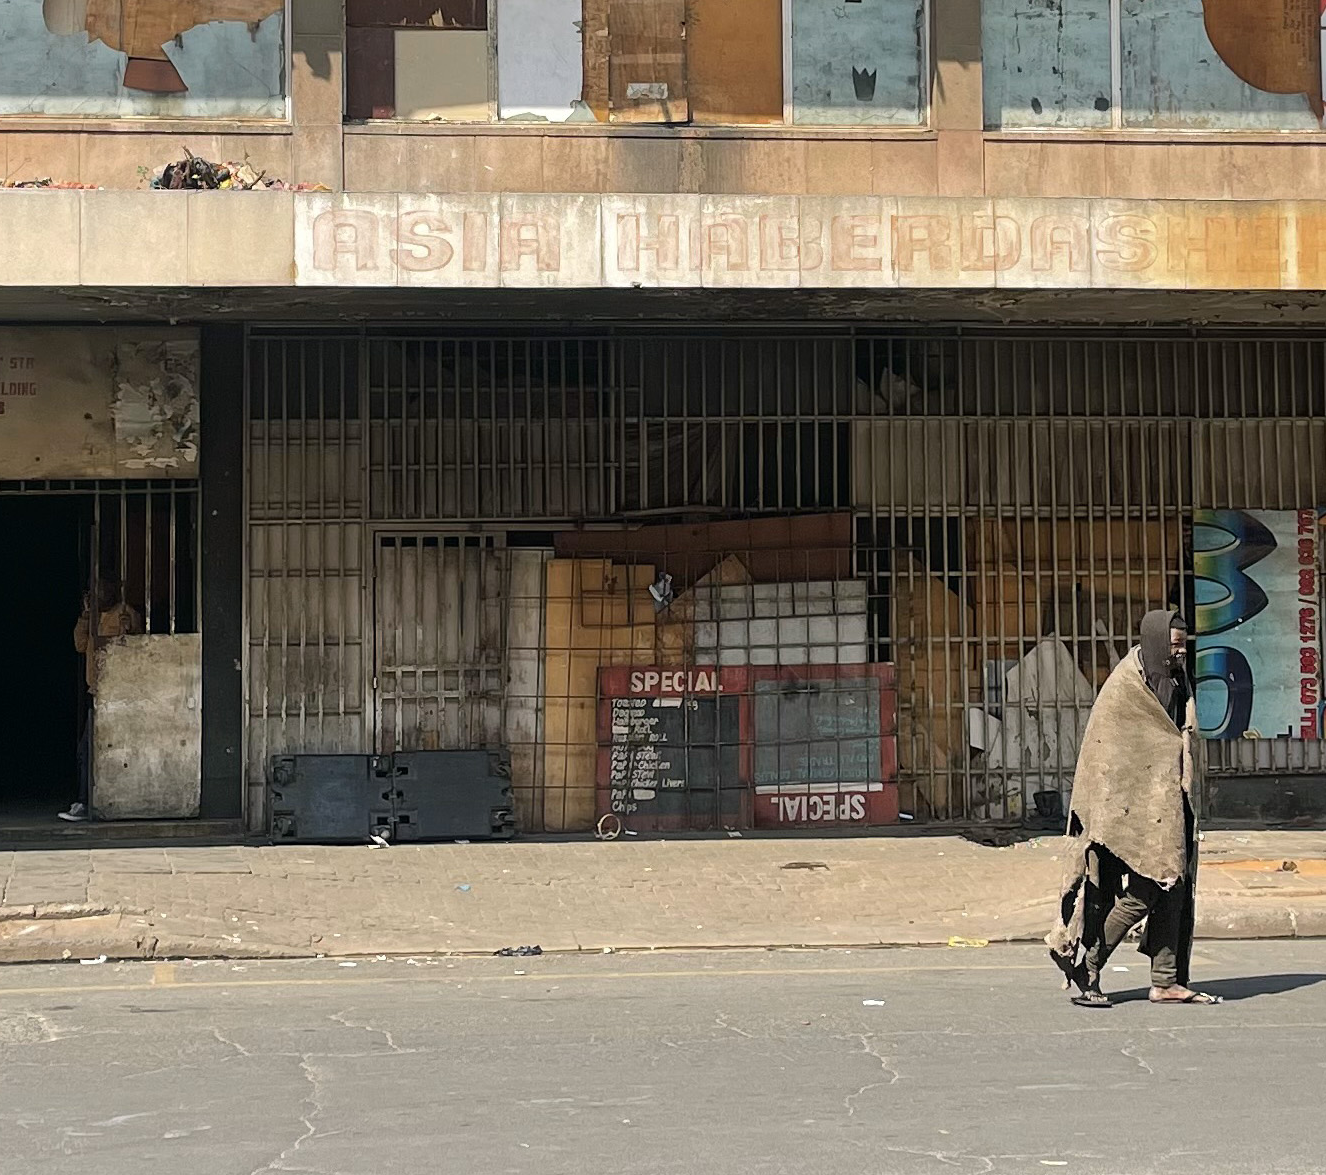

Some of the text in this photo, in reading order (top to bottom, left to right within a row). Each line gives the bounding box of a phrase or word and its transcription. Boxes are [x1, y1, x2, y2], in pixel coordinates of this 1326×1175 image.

[313, 210, 561, 272] ASIA
[631, 671, 724, 693] SPECIAL
[770, 794, 866, 821] SPECIAL
